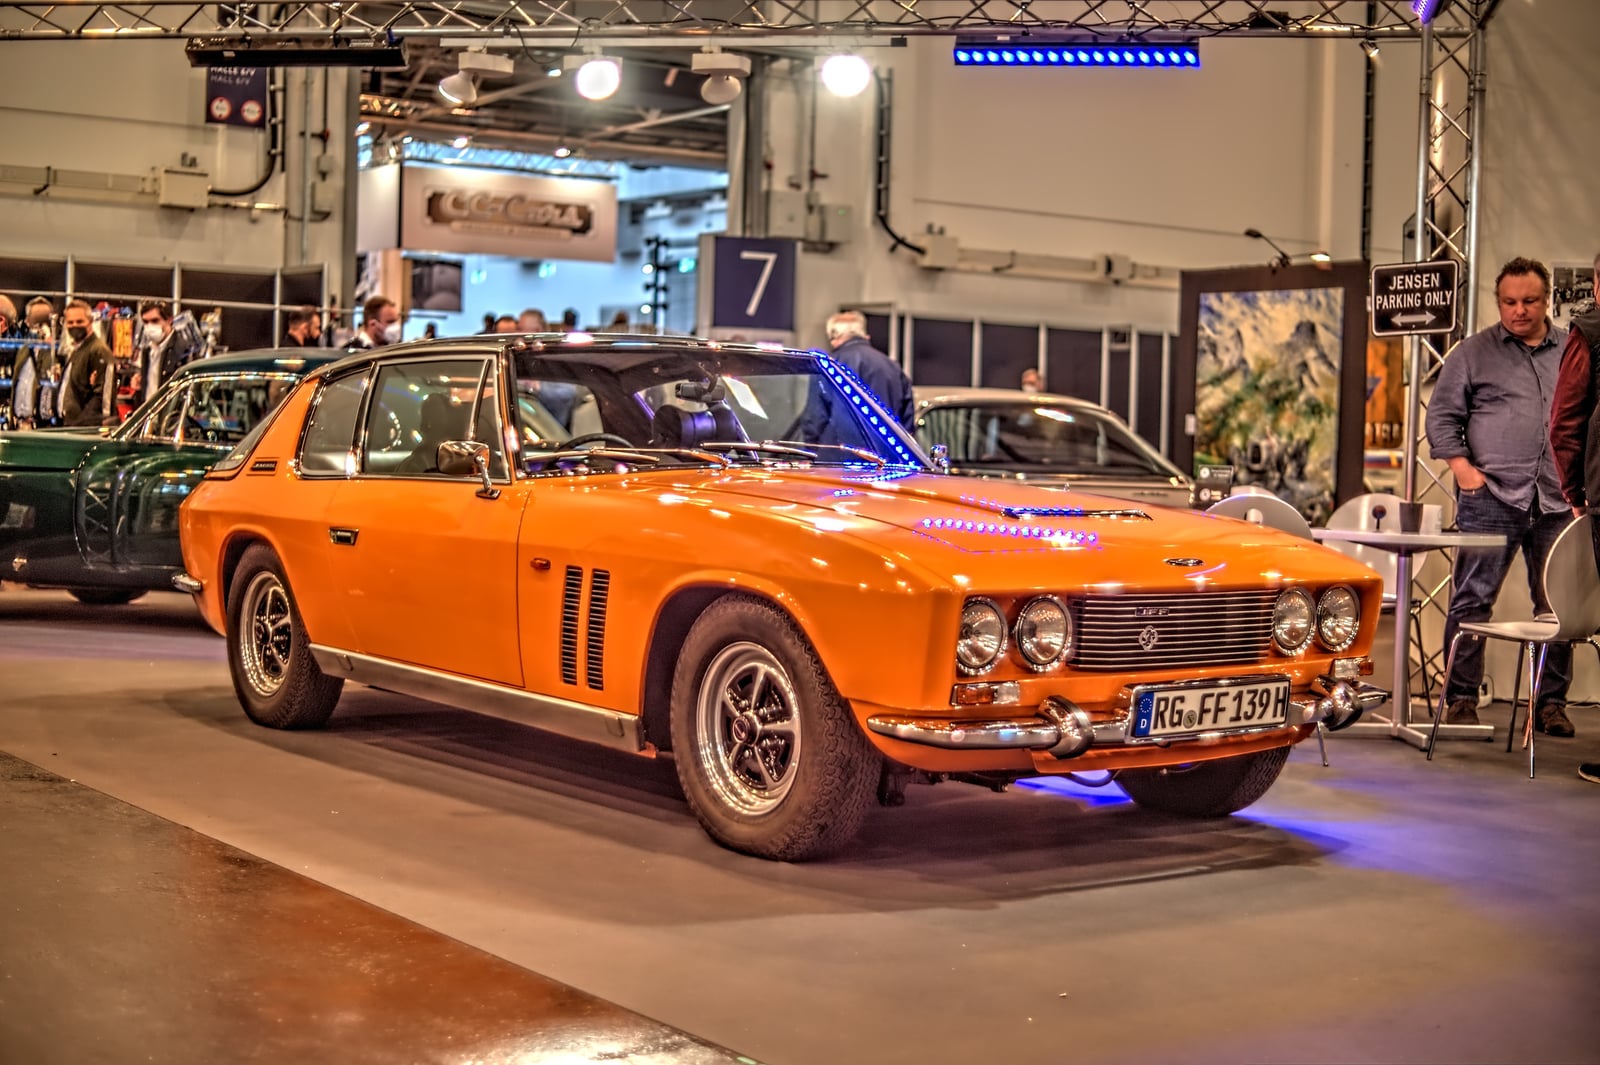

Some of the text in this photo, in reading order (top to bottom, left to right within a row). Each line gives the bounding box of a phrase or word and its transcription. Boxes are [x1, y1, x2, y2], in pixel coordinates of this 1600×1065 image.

[740, 250, 777, 316] 7
[1389, 273, 1440, 290] JENSEN
[1376, 290, 1452, 310] PARKING ONLY
[1140, 718, 1147, 728] D
